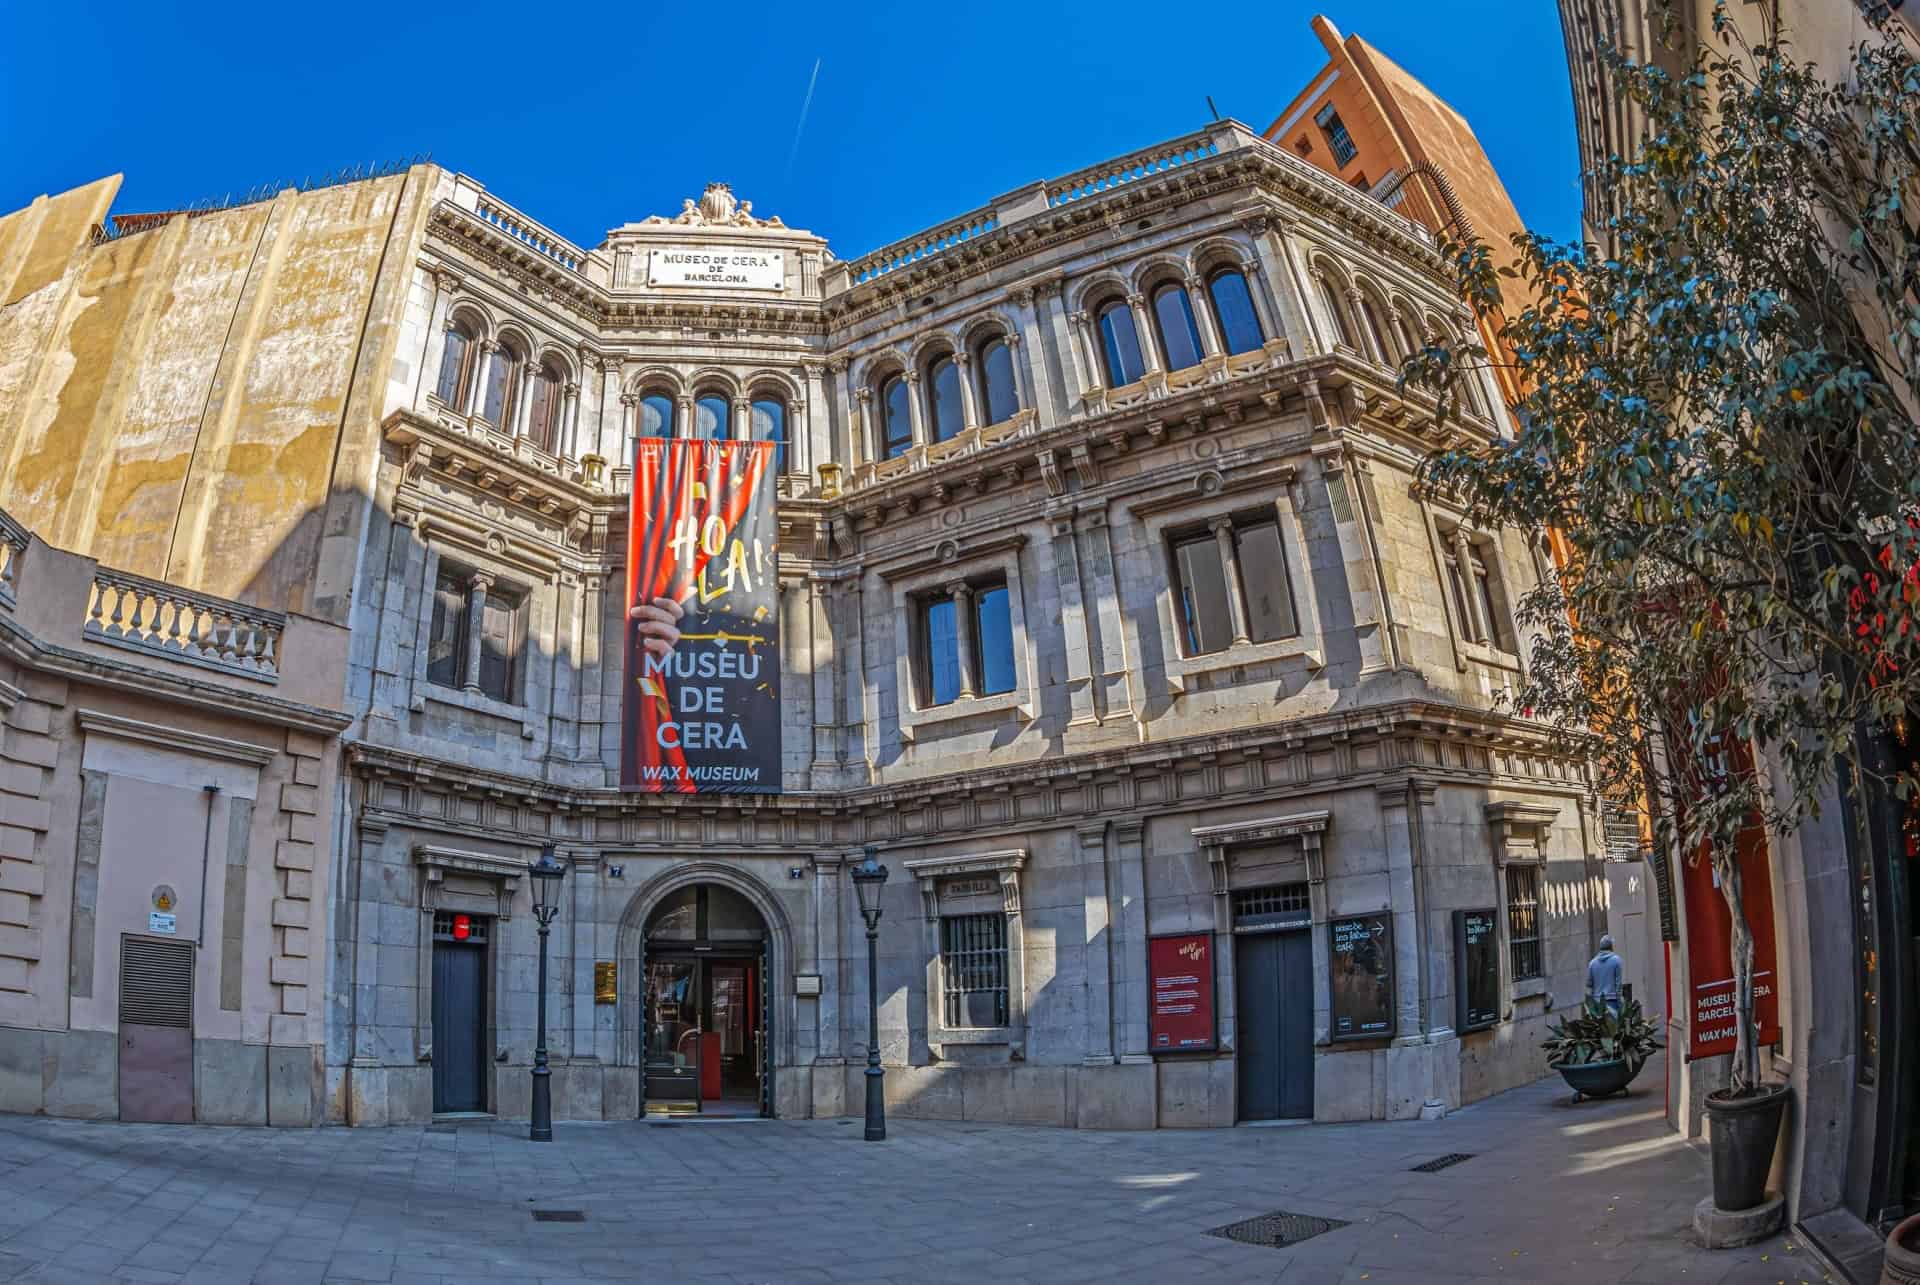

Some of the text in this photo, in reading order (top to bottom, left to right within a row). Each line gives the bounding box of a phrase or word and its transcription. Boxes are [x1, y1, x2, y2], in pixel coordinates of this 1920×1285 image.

[663, 253, 769, 267] MUSEO DE CERA
[708, 265, 724, 273] DE
[684, 273, 749, 283] BARCELONA
[643, 651, 760, 680] MUSEU
[679, 686, 725, 713] DE
[655, 721, 749, 750] CERA
[642, 765, 760, 781] WAX MUSEUM
[1697, 993, 1730, 1009] MUSEU
[1699, 1030, 1721, 1043] WAX
